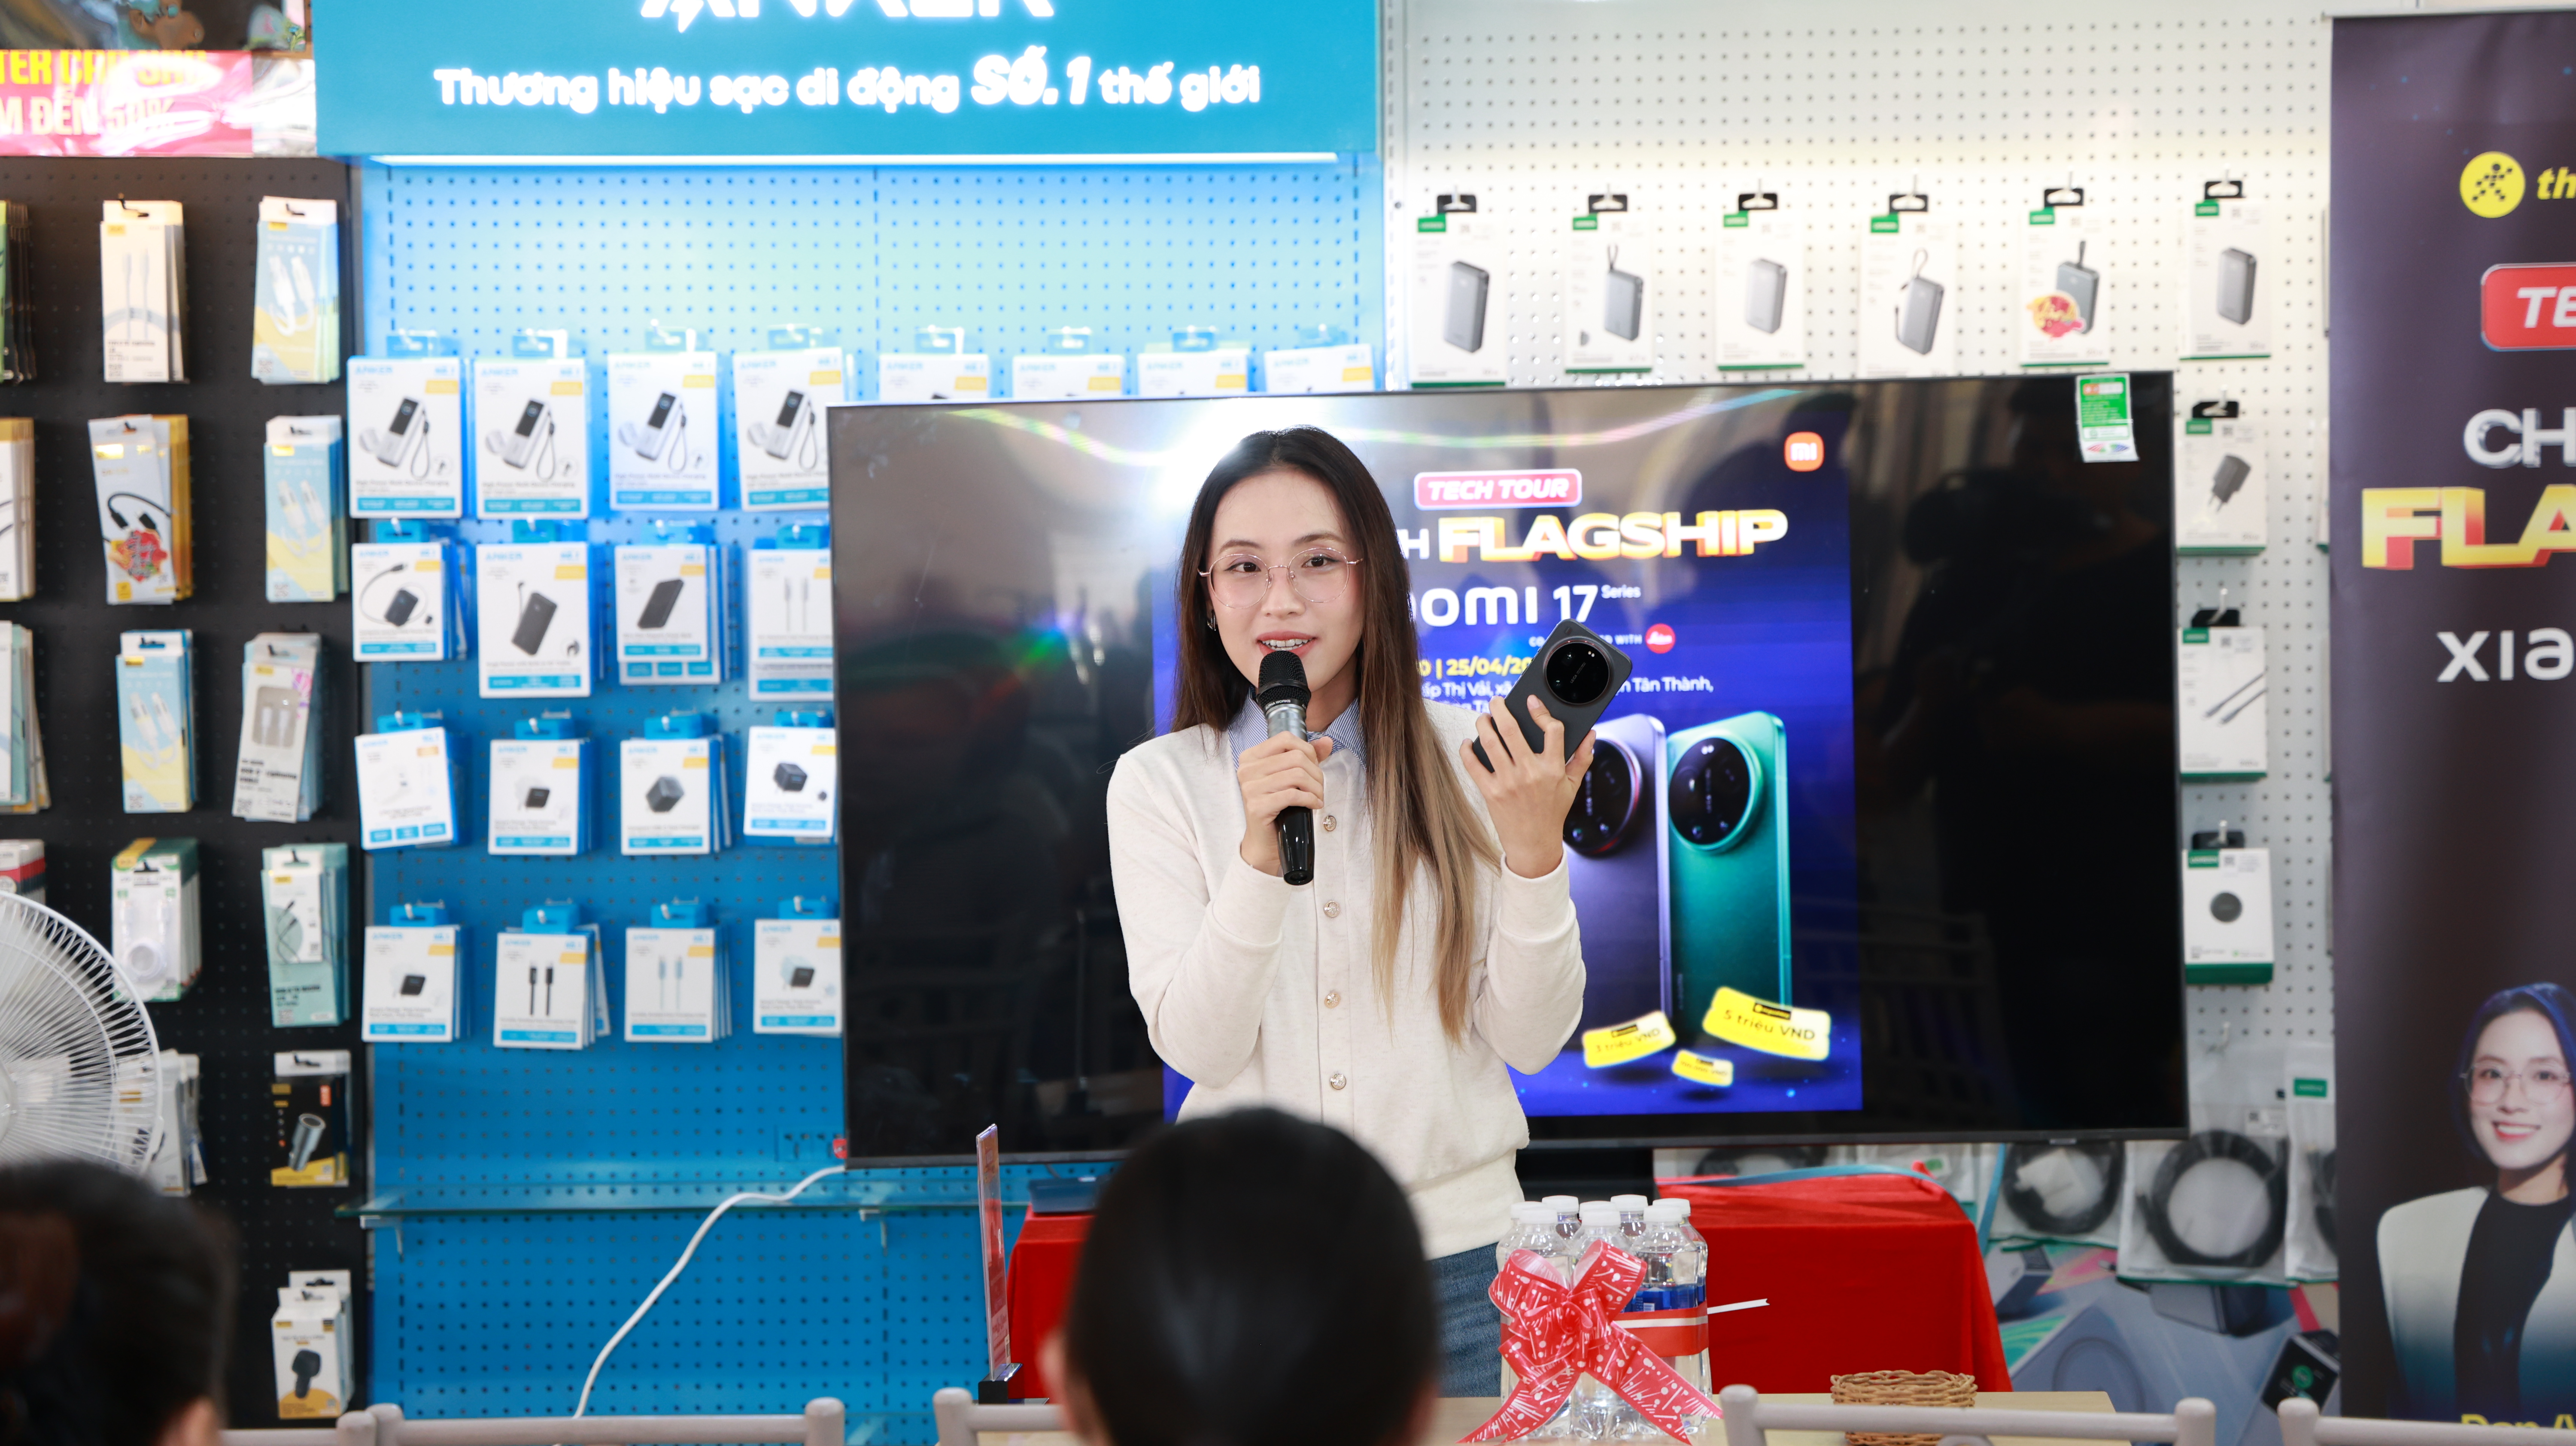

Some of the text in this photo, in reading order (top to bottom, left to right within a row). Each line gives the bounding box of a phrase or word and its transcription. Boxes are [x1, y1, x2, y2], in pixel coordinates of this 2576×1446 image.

[434, 67, 598, 113] Thương
[608, 67, 700, 113] hiệu
[710, 75, 789, 113] sạc
[796, 67, 838, 106] di
[847, 67, 959, 113] động
[1098, 62, 1174, 104] thế
[1180, 64, 1260, 112] giới
[2463, 407, 2576, 468] CH
[1428, 478, 1570, 501] TECH TOUR
[1398, 509, 1788, 563] H FLAGSHIP
[1410, 585, 1641, 627] omi 17 Series
[1528, 636, 1546, 647] CO
[1615, 634, 1642, 645] WITH
[1631, 677, 1660, 693] Tân
[1661, 676, 1713, 693] Thành,
[1780, 1025, 1816, 1040] VND
